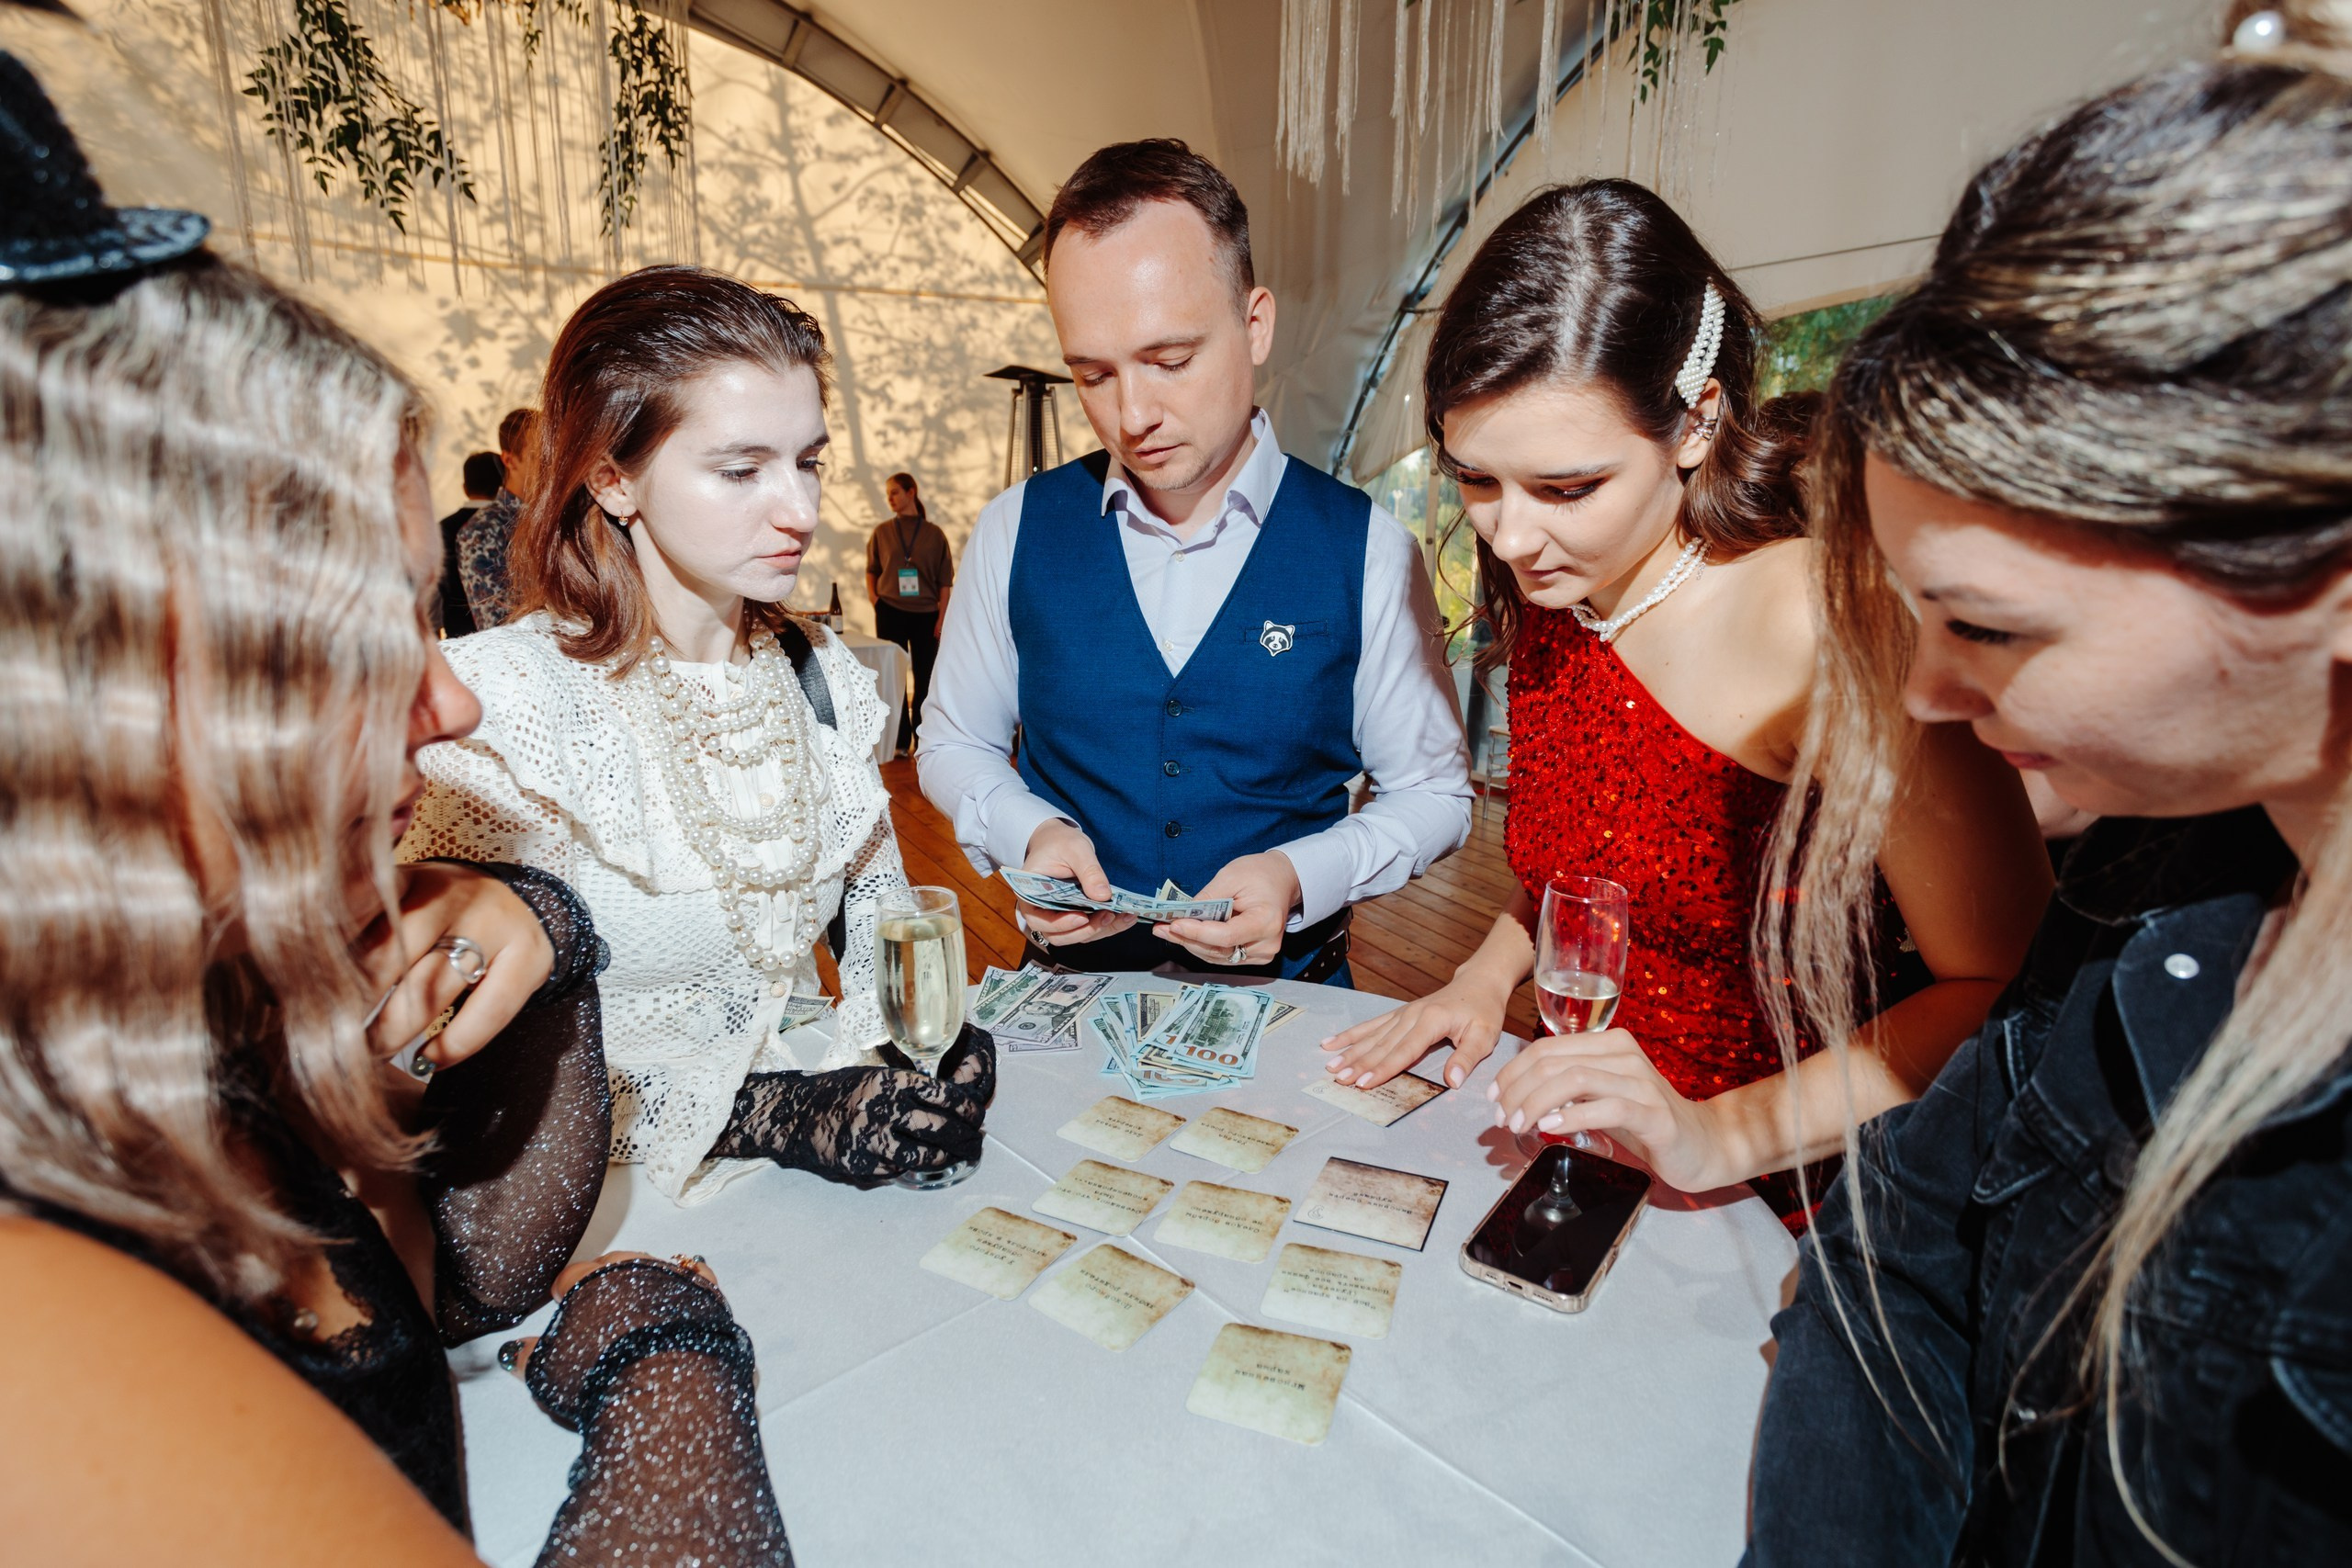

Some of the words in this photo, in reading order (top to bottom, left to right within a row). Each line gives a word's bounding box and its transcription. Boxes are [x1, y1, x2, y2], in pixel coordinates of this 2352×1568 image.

[1184, 1045, 1238, 1066] 100
[1185, 1213, 1220, 1224] борьбы
[1191, 1205, 1246, 1222] обнаружено
[968, 1226, 992, 1237] крови
[1226, 1222, 1260, 1233] Следов
[977, 1238, 1022, 1258] обнаружен
[1007, 1240, 1047, 1258] алкоголь
[1080, 1269, 1120, 1292] родители
[1125, 1292, 1155, 1309] любили
[1256, 1363, 1290, 1375] карма
[1234, 1370, 1306, 1391] Мгновенная
